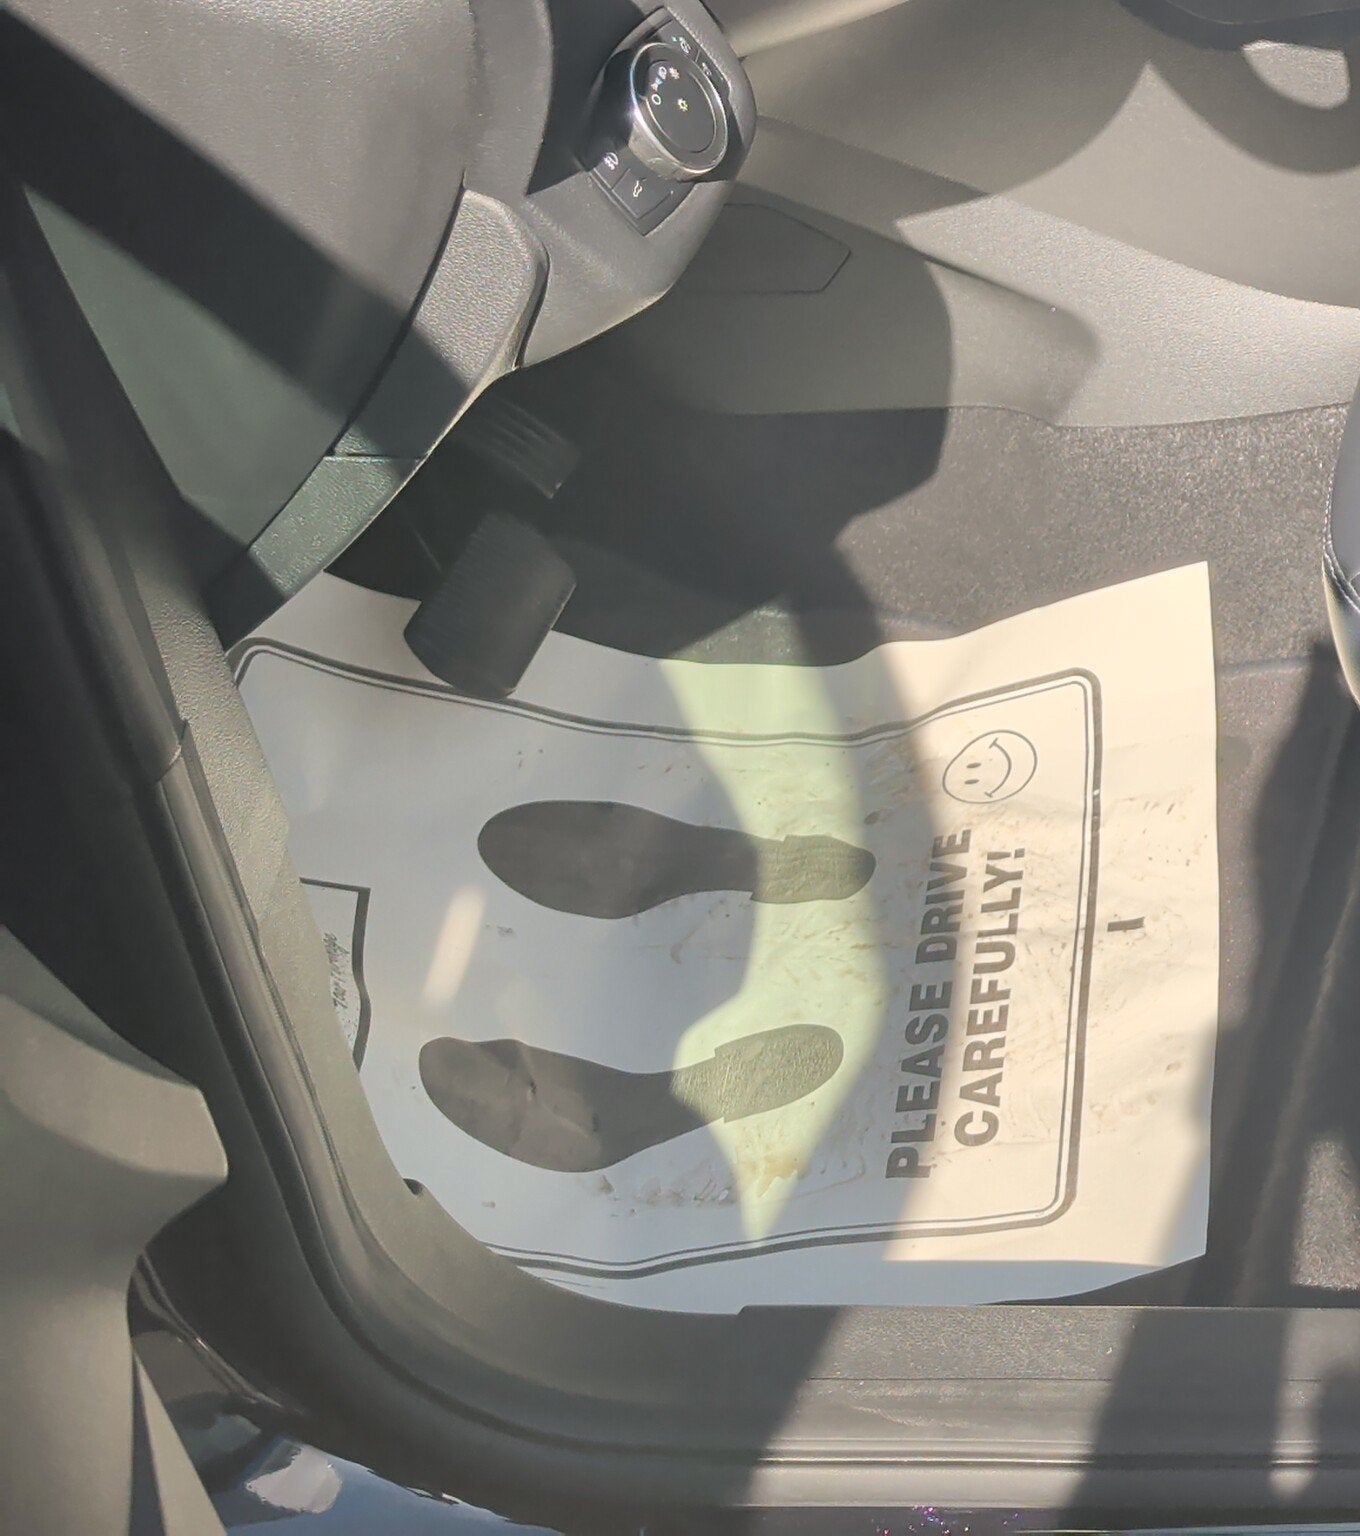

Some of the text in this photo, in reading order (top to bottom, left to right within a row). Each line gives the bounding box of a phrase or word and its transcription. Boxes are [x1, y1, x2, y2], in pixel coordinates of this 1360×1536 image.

[885, 828, 972, 1179] PLEASE DRIVE
[954, 847, 1026, 1147] CAREFULLY!
